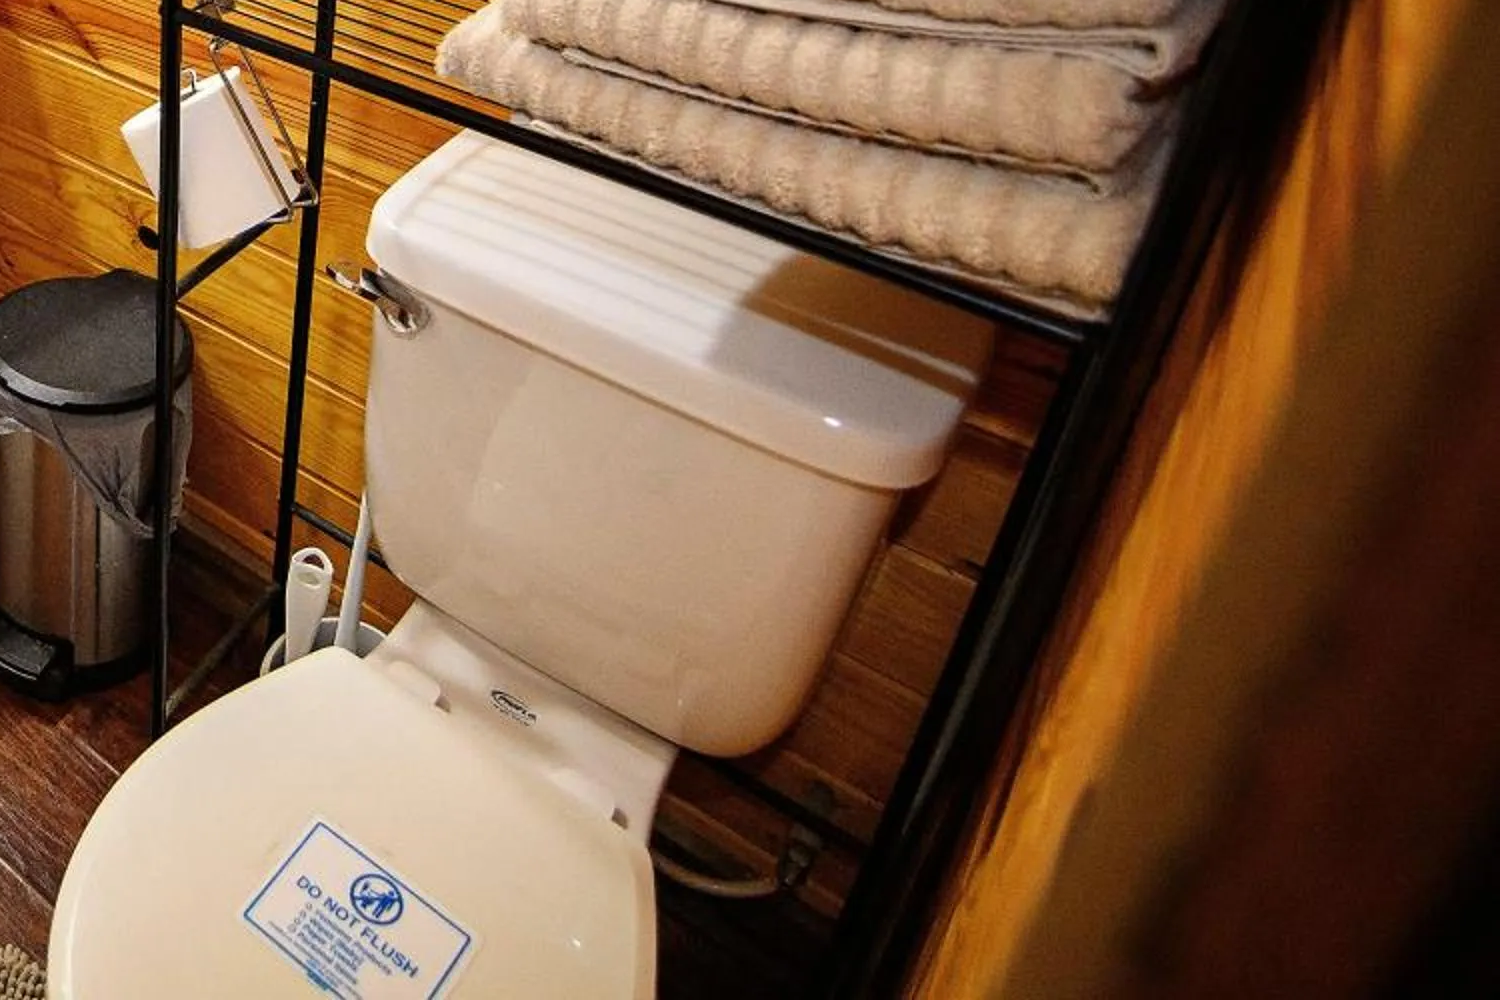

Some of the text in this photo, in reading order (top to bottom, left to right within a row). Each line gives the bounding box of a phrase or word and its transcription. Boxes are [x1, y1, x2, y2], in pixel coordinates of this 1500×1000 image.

[296, 874, 323, 899] DO
[323, 897, 361, 929] NOT
[360, 926, 420, 978] FLUSH
